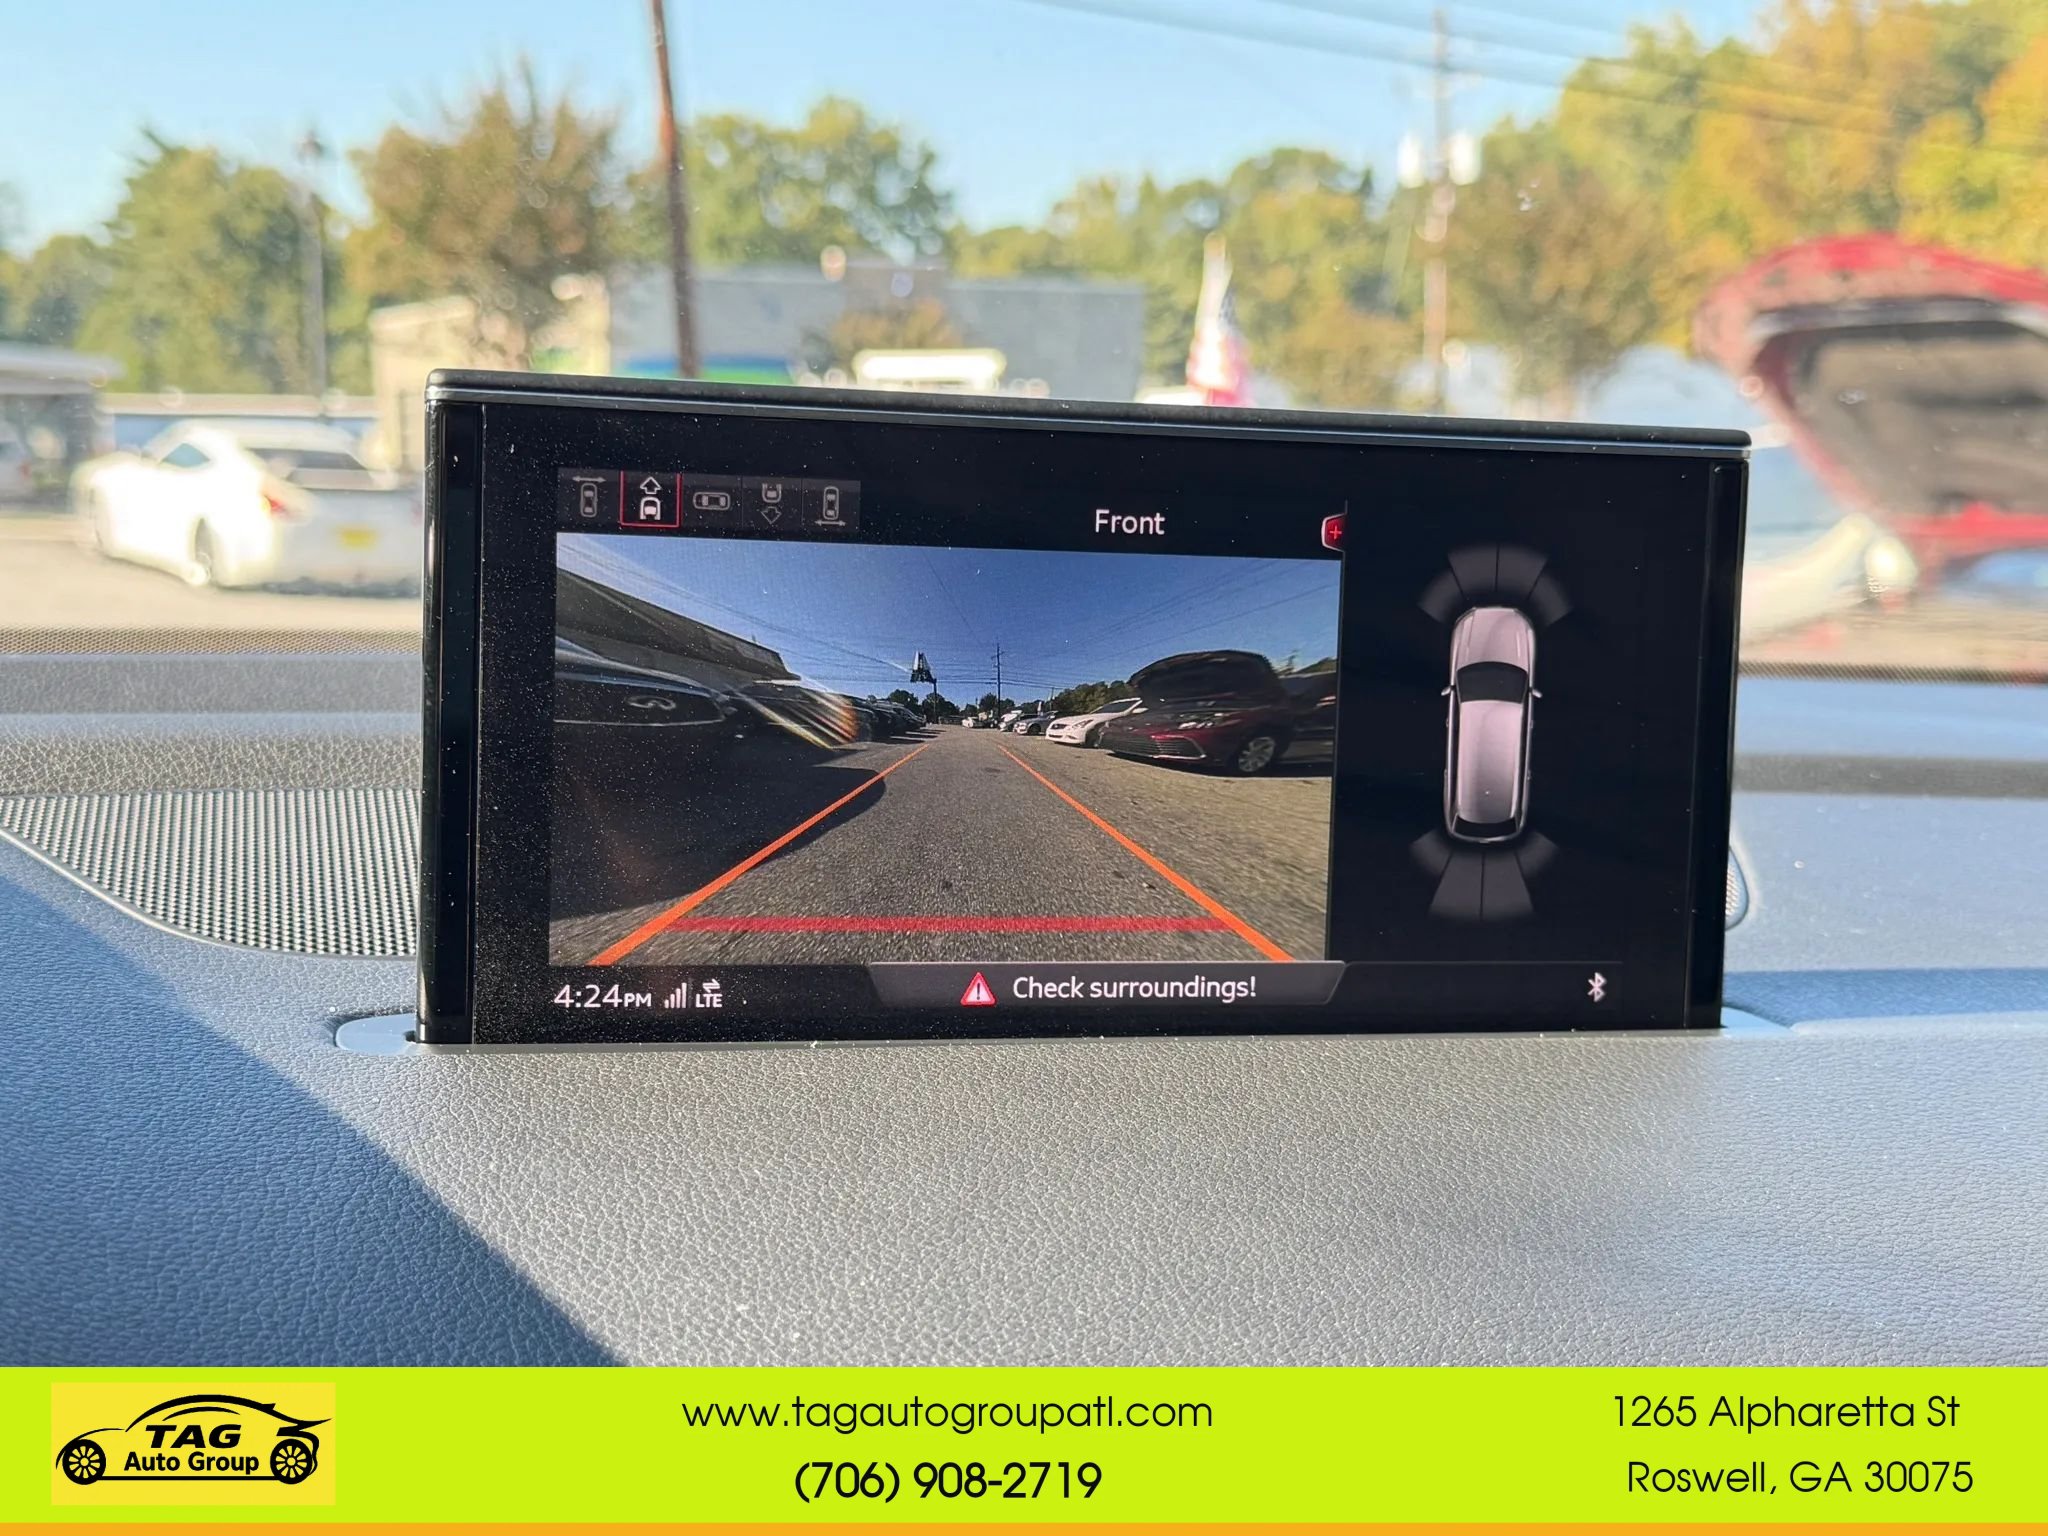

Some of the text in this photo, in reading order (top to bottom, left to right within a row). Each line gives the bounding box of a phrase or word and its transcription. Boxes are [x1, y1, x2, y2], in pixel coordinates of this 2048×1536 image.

[1093, 508, 1166, 536] Front
[695, 993, 723, 1008] LTE
[1012, 974, 1257, 1005] Check surroundings!
